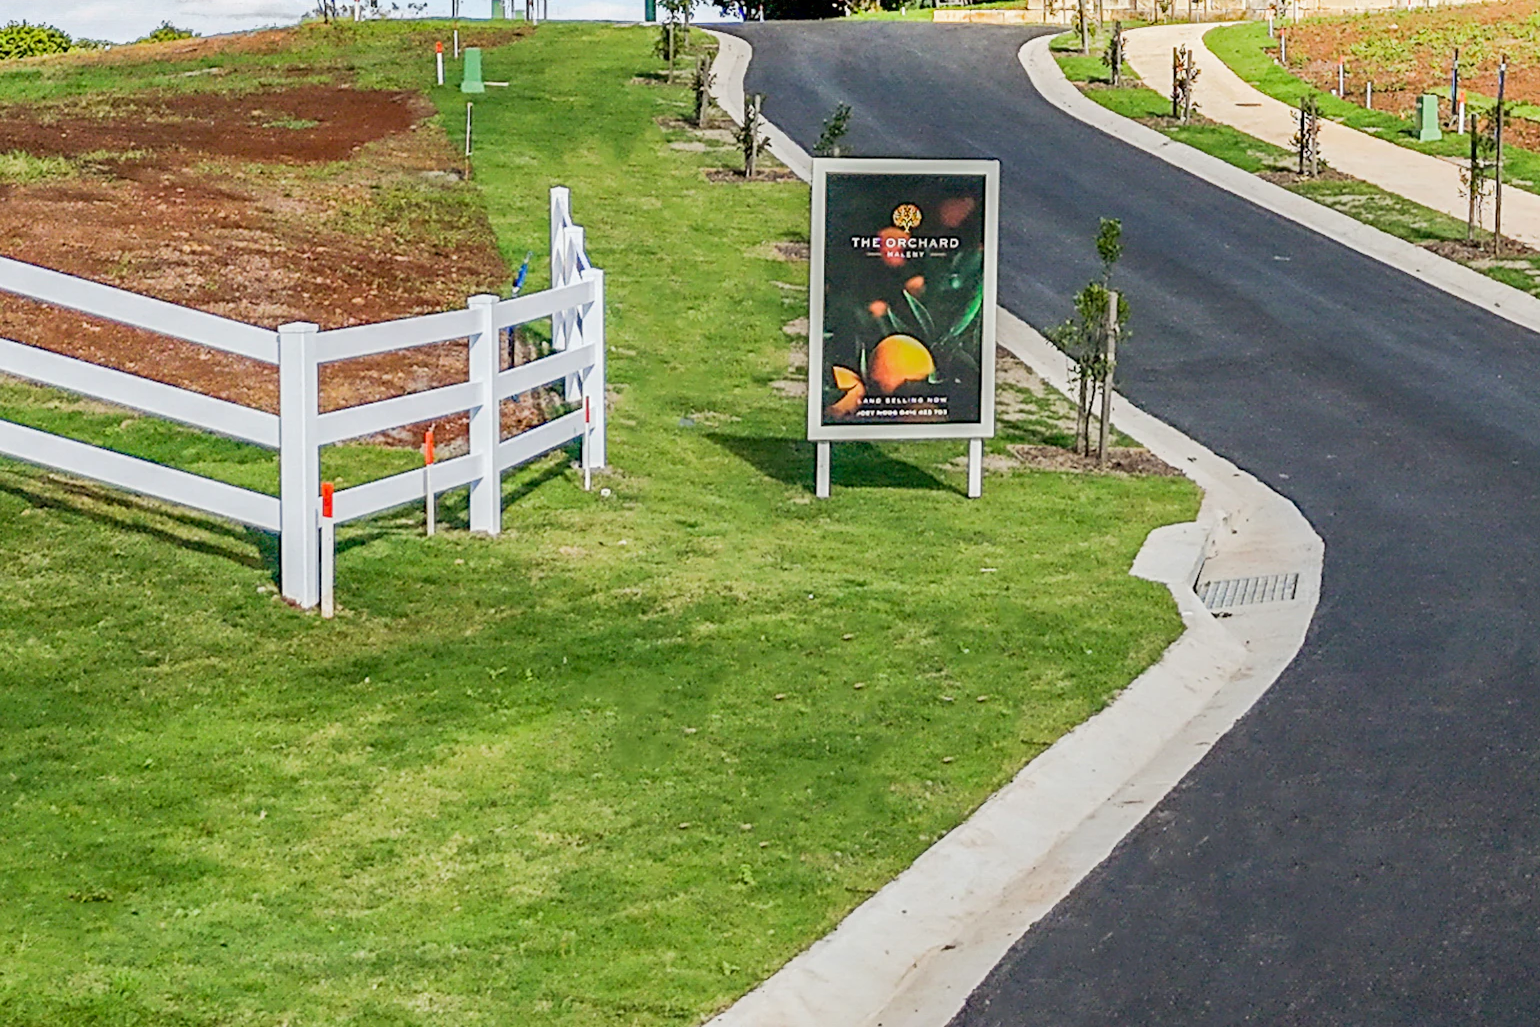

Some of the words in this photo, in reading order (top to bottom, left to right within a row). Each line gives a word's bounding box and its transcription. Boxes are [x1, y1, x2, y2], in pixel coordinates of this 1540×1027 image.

[851, 237, 881, 248] THE
[885, 237, 960, 248] ORCHARD
[887, 251, 925, 259] MALENY
